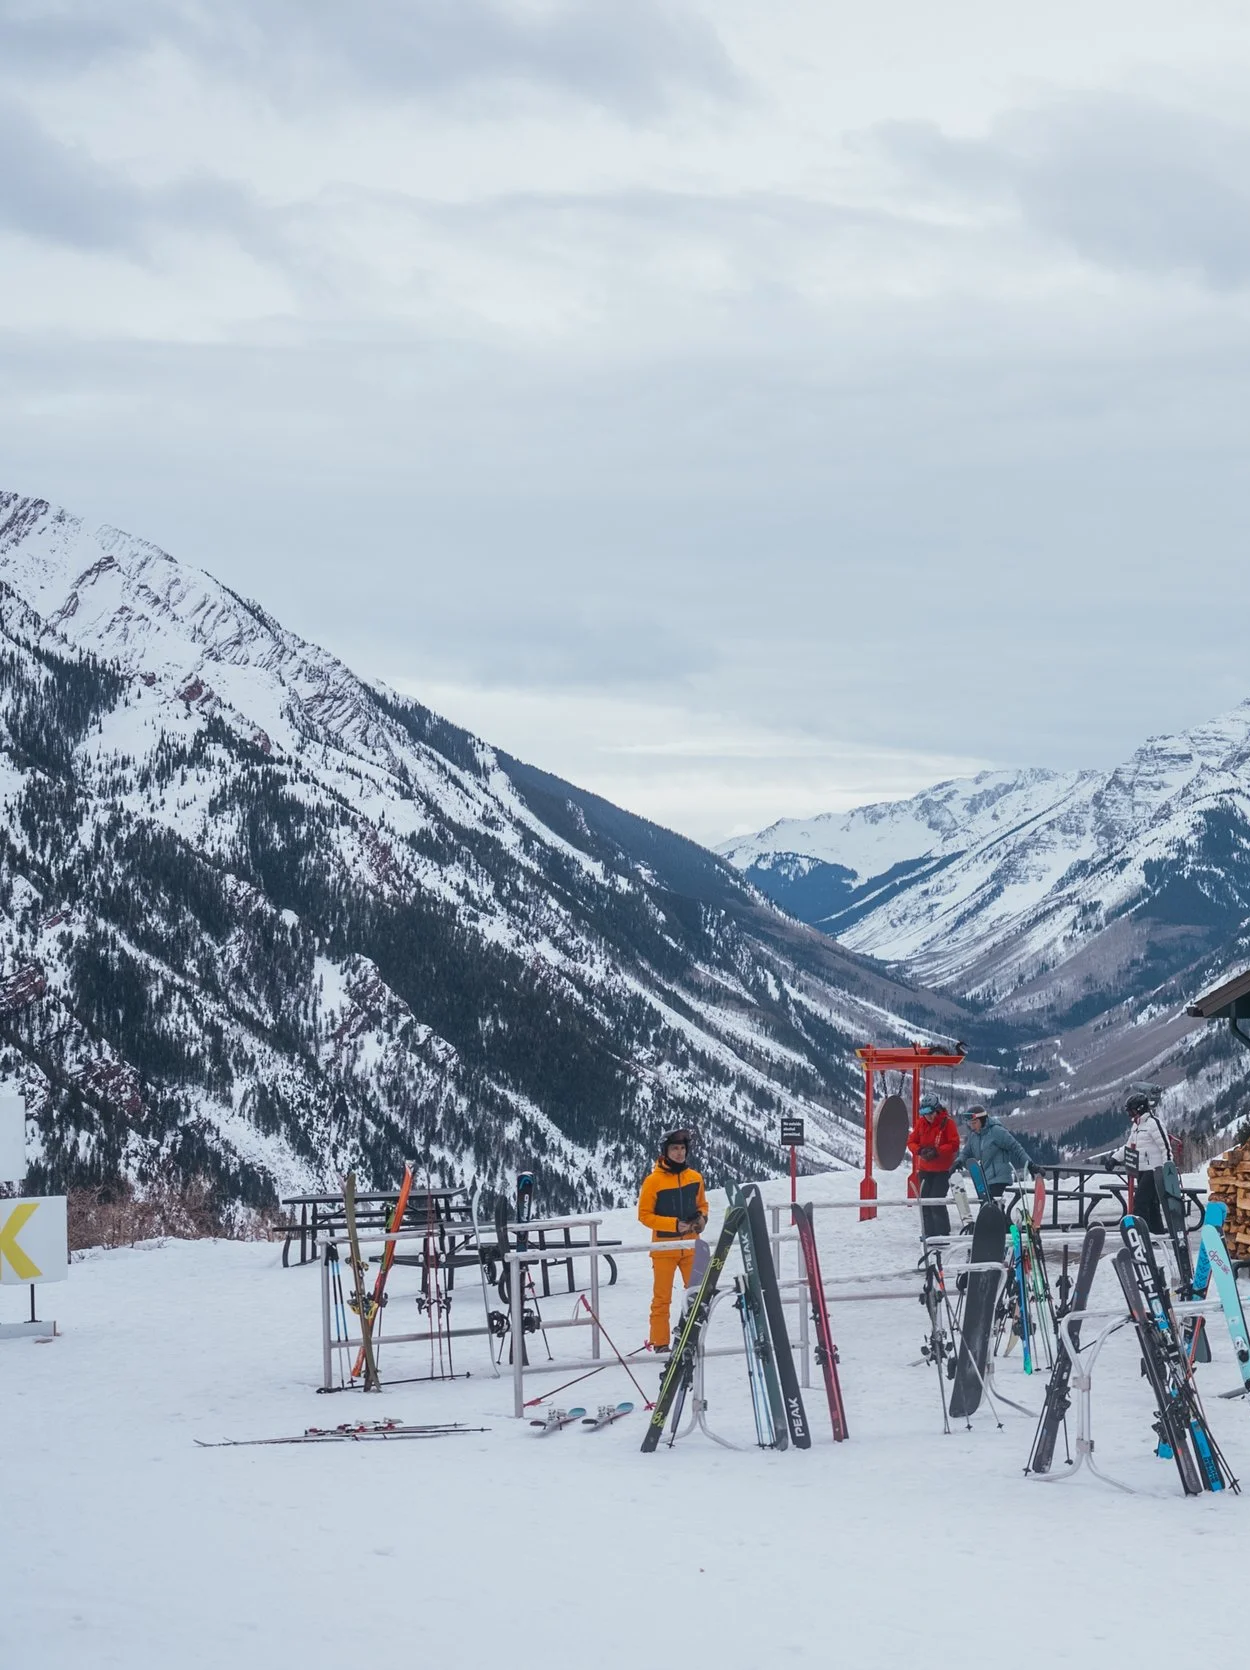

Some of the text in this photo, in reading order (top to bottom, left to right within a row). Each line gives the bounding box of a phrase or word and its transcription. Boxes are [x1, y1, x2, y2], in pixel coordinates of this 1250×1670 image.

[741, 1232, 754, 1272] PEAK
[1127, 1228, 1158, 1299] HEAD
[1208, 1250, 1225, 1268] dps
[788, 1397, 805, 1437] PEAK
